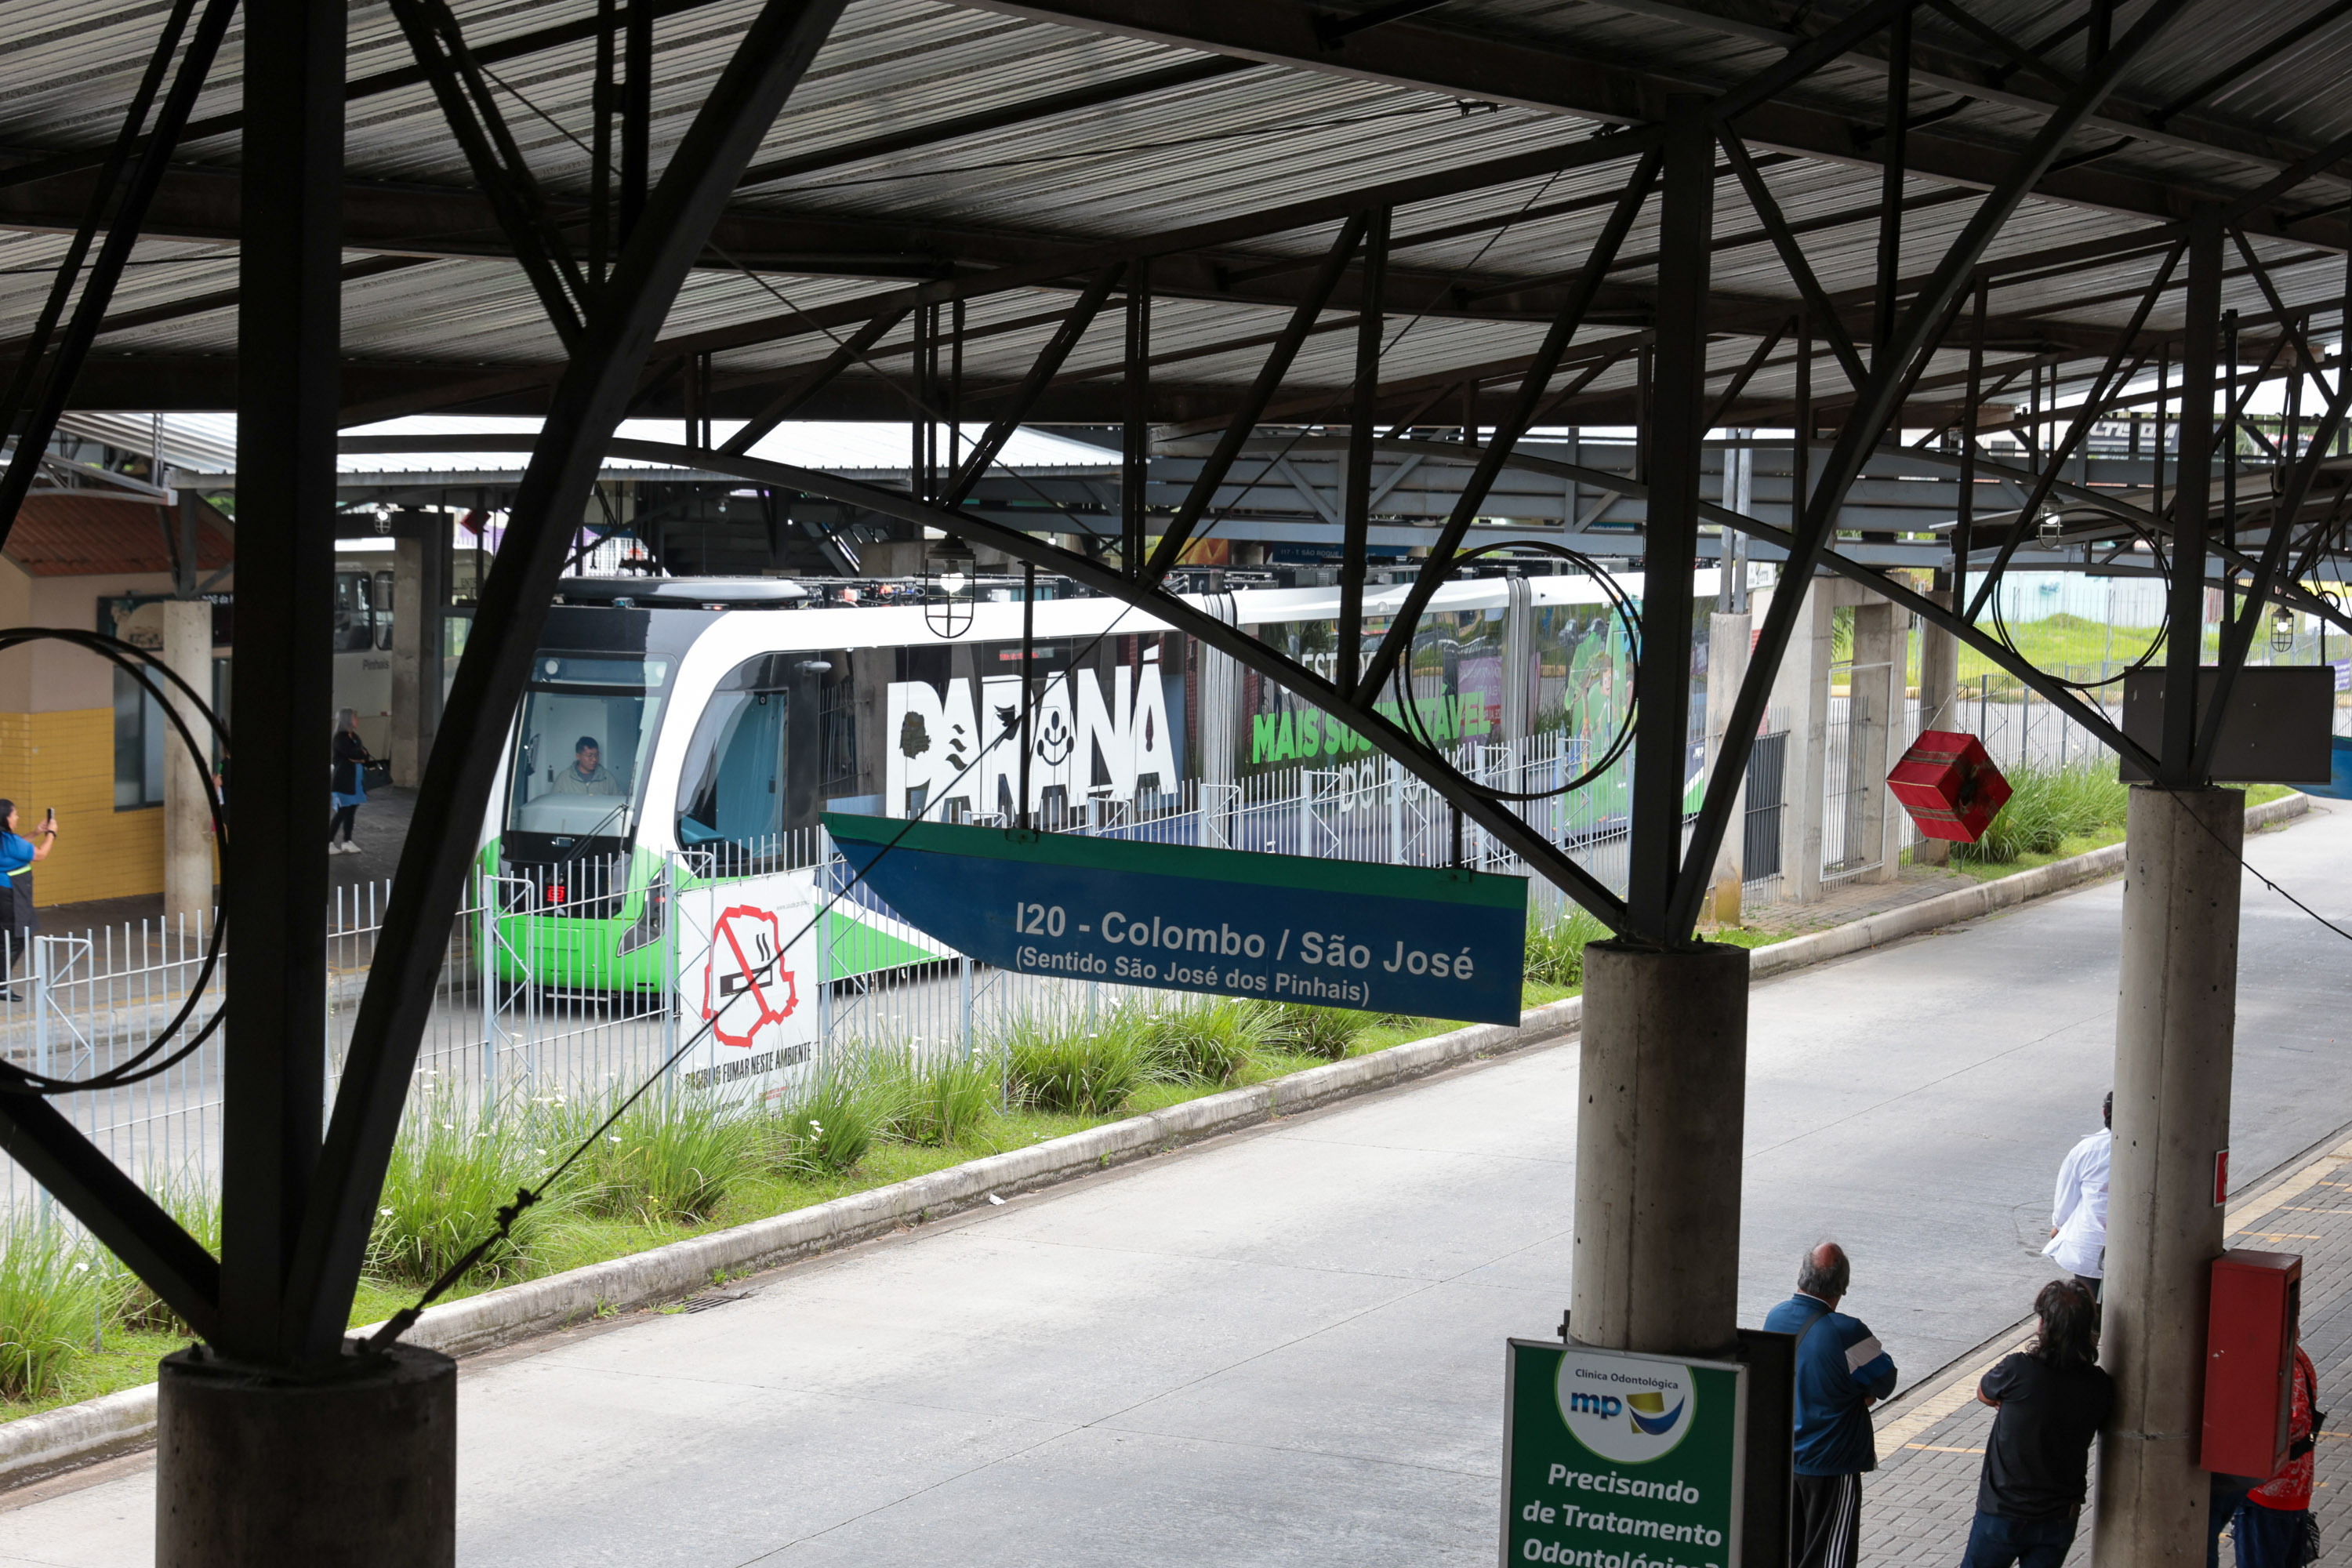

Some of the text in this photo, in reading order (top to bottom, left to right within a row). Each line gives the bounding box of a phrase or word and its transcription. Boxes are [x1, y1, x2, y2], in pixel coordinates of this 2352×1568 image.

[1253, 708, 1319, 764] MAIS
[1102, 911, 1265, 958] Colombo
[1276, 929, 1290, 960] /
[1300, 931, 1370, 969] São
[1383, 941, 1474, 979] José
[1016, 946, 1369, 1007] (Sentido São José dos Pinhais)
[723, 1058, 750, 1083] FUMAR
[751, 1051, 774, 1076] NESTE
[775, 1042, 811, 1069] AMBIENTE
[1575, 1368, 1679, 1390] Clínica Odontológica
[1570, 1392, 1622, 1421] mp
[1548, 1463, 1700, 1504] Precisando
[1523, 1500, 1722, 1547] de Tratamento
